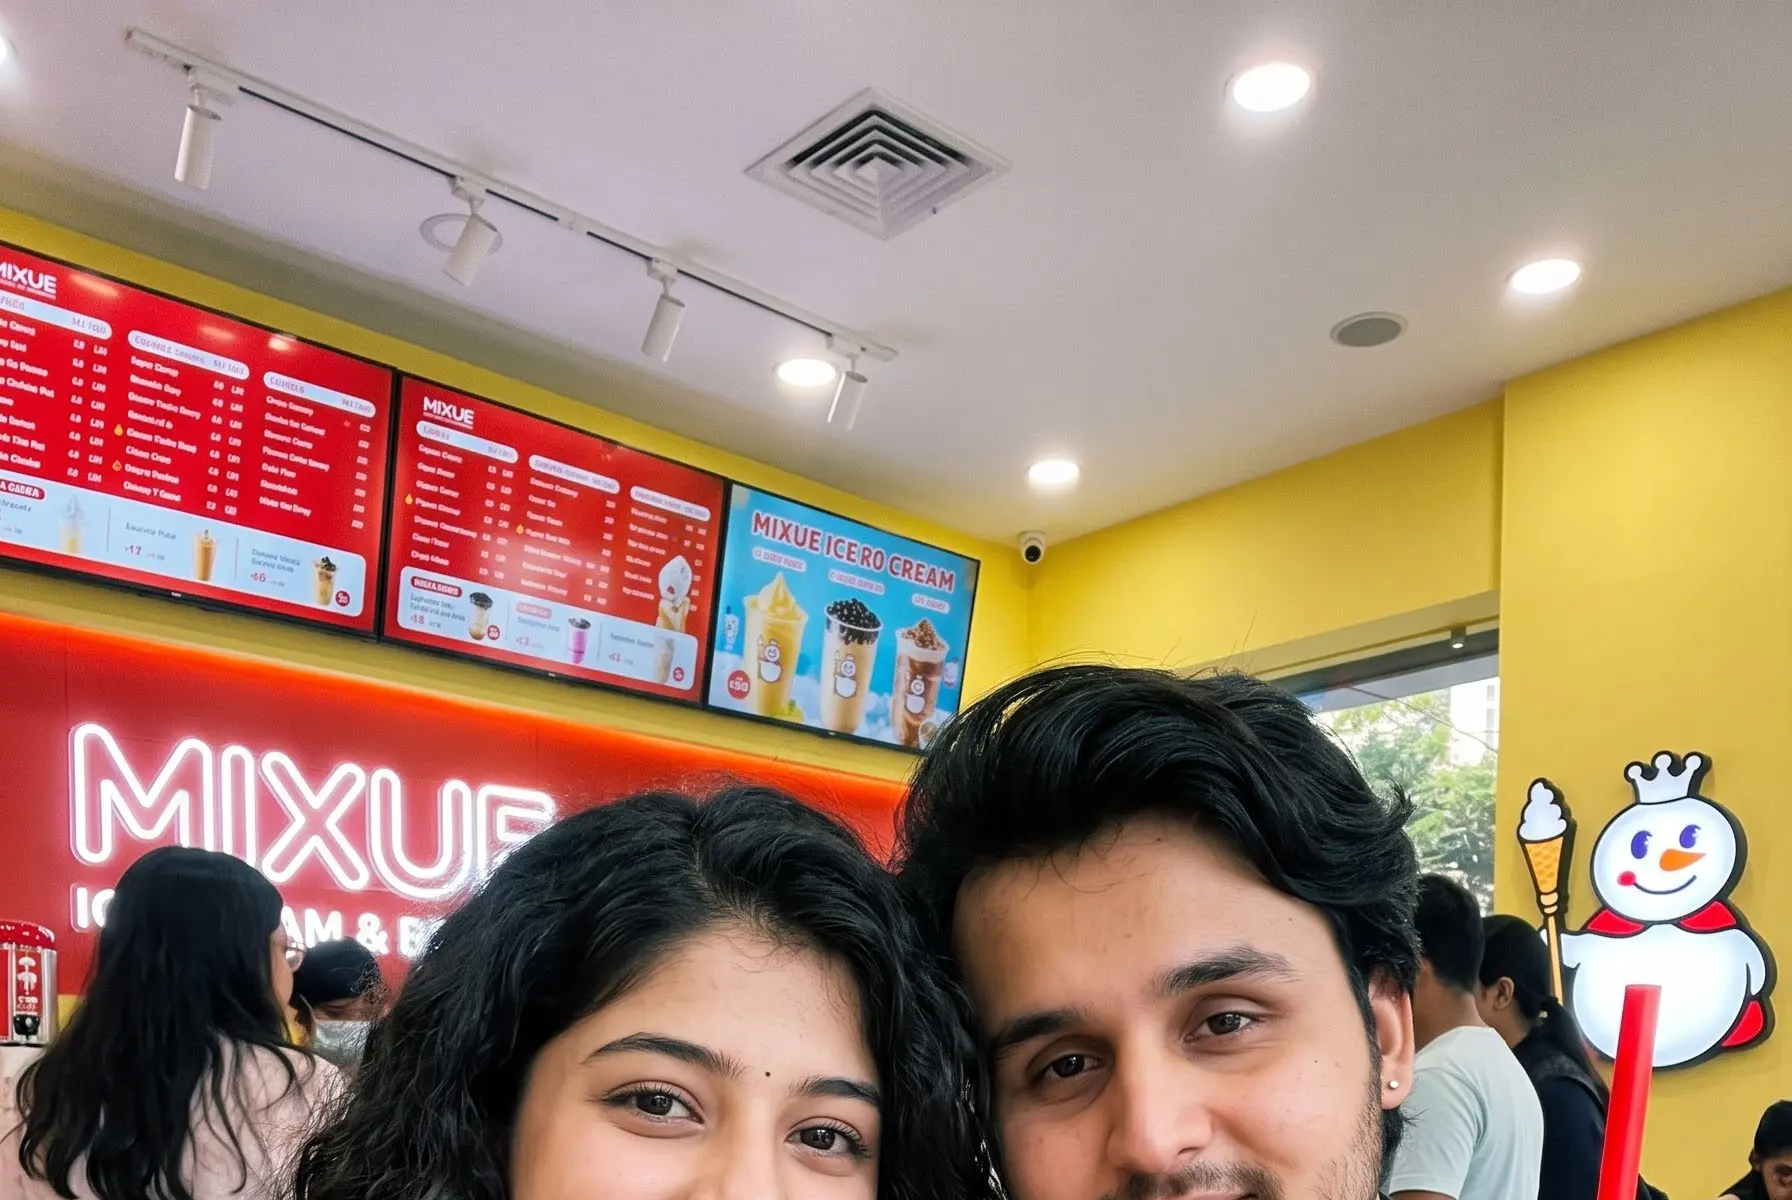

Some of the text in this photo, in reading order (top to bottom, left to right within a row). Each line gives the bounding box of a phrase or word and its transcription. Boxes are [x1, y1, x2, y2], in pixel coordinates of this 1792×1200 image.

[423, 396, 475, 425] MIXUE
[753, 512, 821, 551] MIXUE
[826, 535, 858, 563] ICE
[888, 556, 955, 591] CREAM
[356, 912, 389, 956] &
